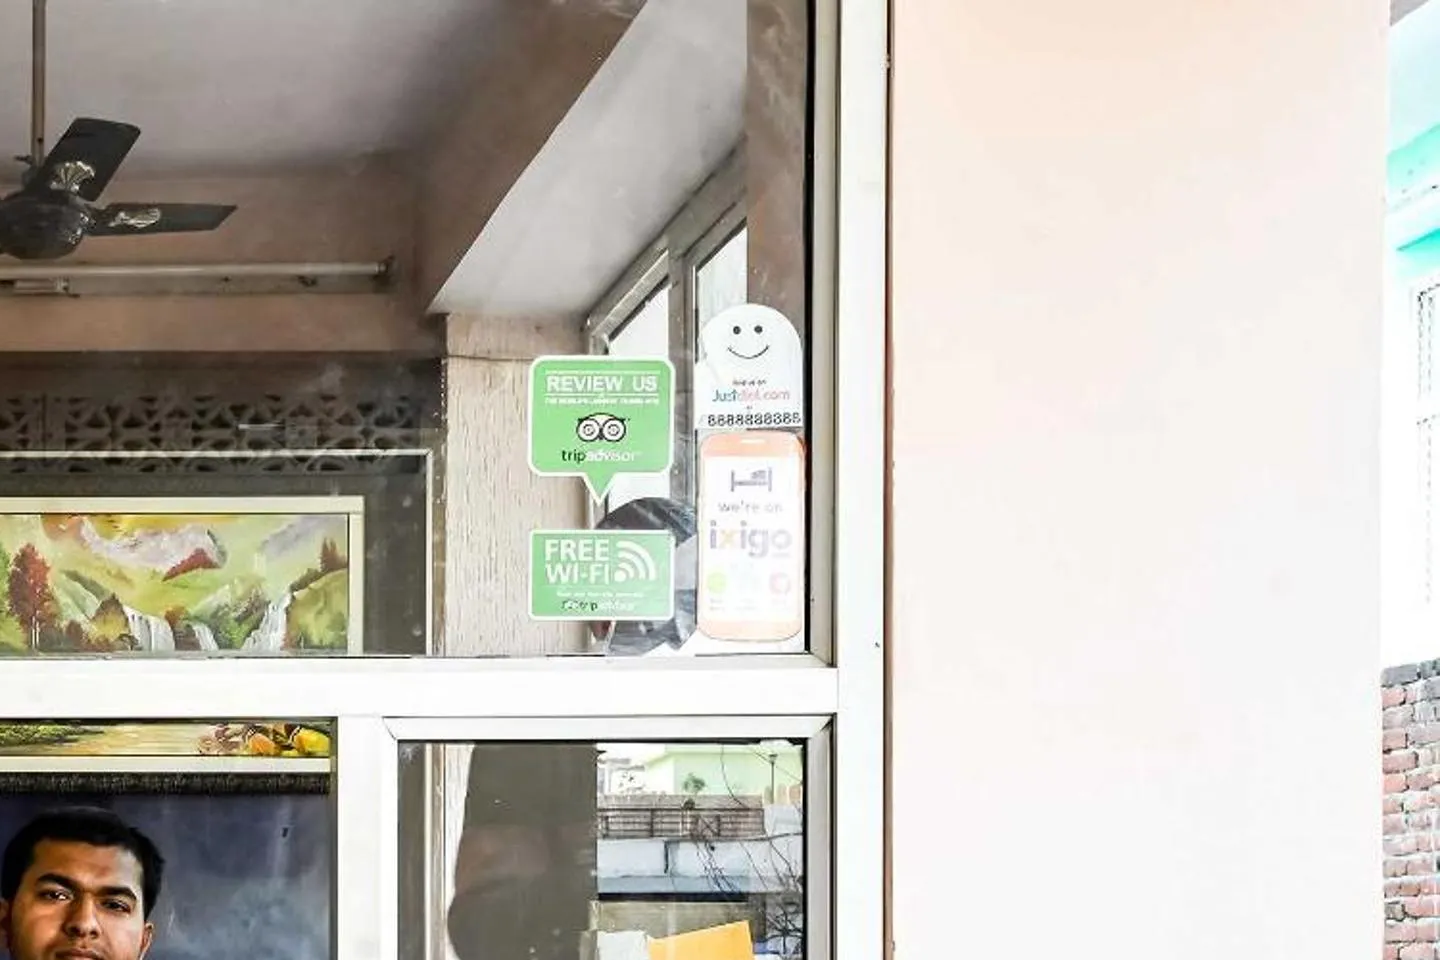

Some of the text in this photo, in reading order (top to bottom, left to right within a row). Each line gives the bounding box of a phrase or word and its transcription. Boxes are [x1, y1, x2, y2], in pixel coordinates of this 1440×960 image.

[546, 375, 658, 392] REVIEW US
[561, 449, 635, 464] tripadvisor
[710, 519, 792, 558] ixigo
[545, 539, 609, 561] FREE
[544, 562, 609, 585] WI-FI
